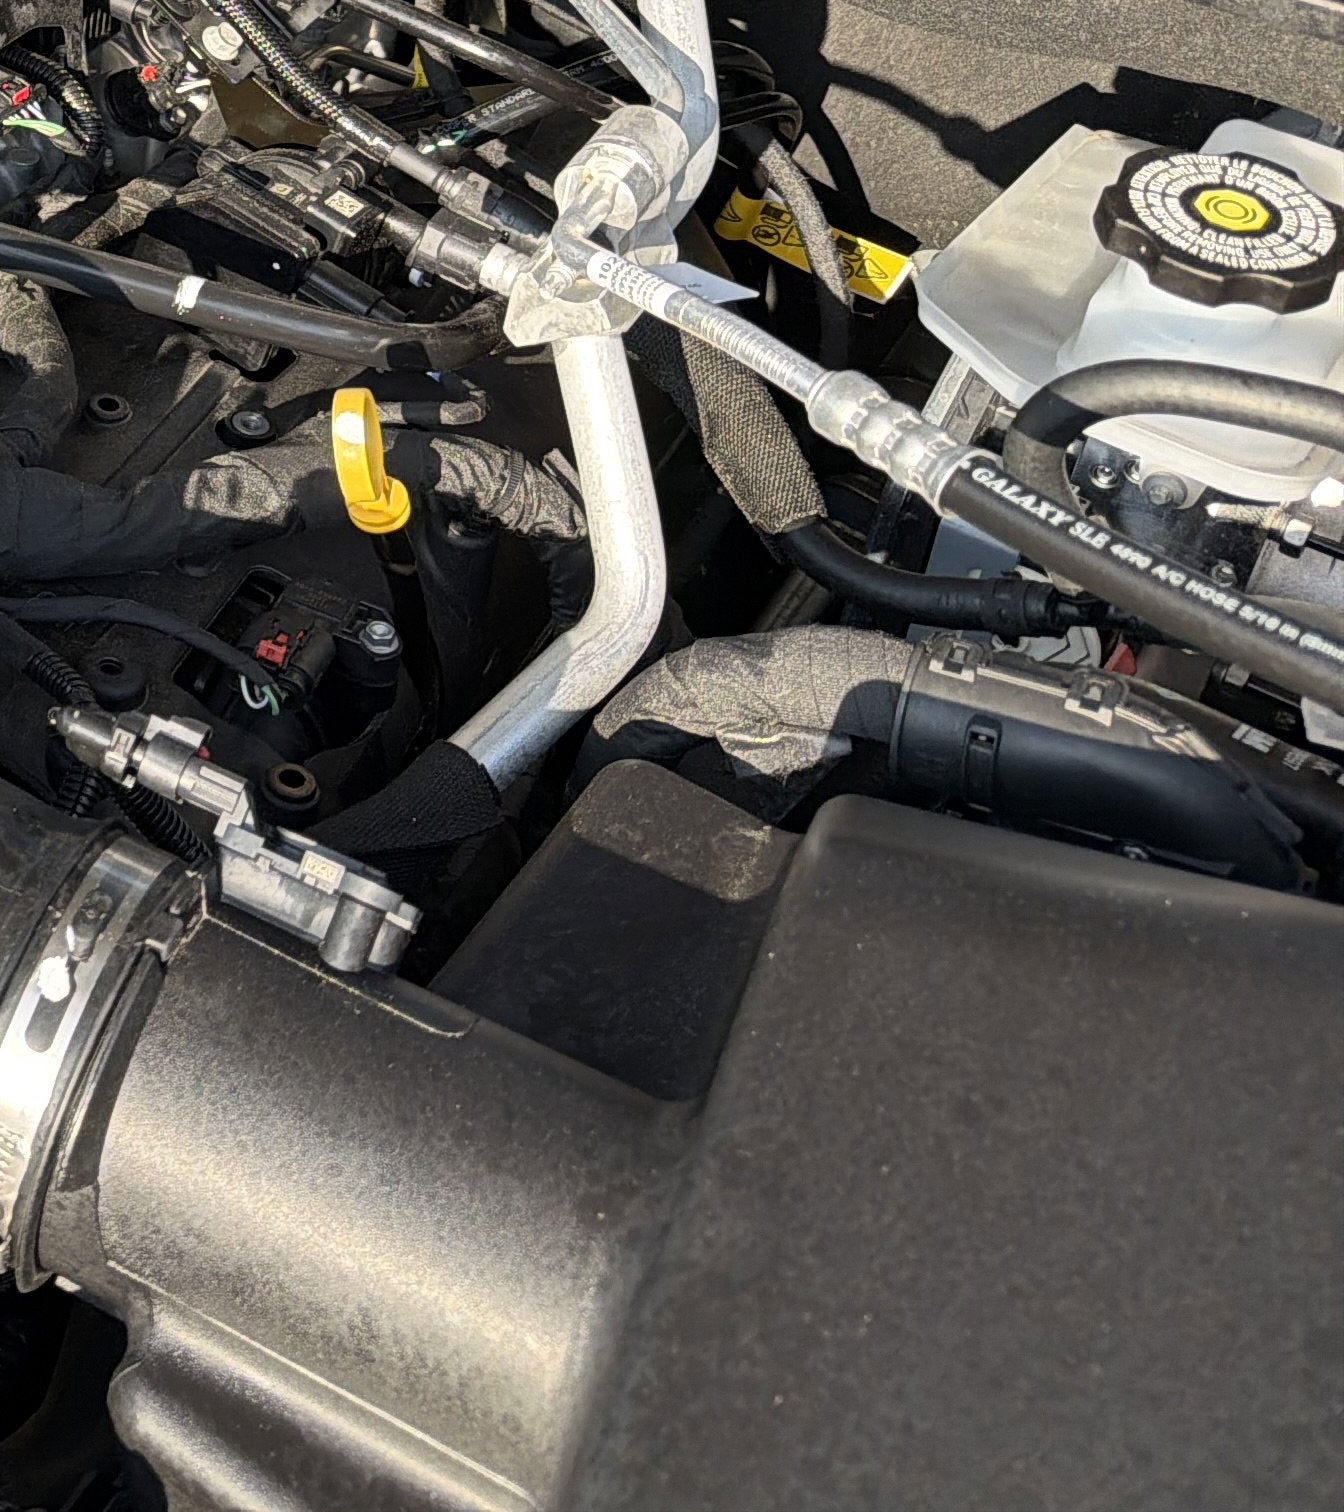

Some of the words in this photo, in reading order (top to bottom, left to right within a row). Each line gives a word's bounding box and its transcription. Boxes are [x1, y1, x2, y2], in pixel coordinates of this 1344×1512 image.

[1203, 229, 1244, 248] CLEAN
[1244, 233, 1287, 249] FILLER
[1199, 248, 1248, 269] SEALED
[972, 466, 1076, 528] GALAXY
[1068, 520, 1112, 550] SLE
[1151, 563, 1187, 588] A/C
[1185, 579, 1241, 614] HOSE
